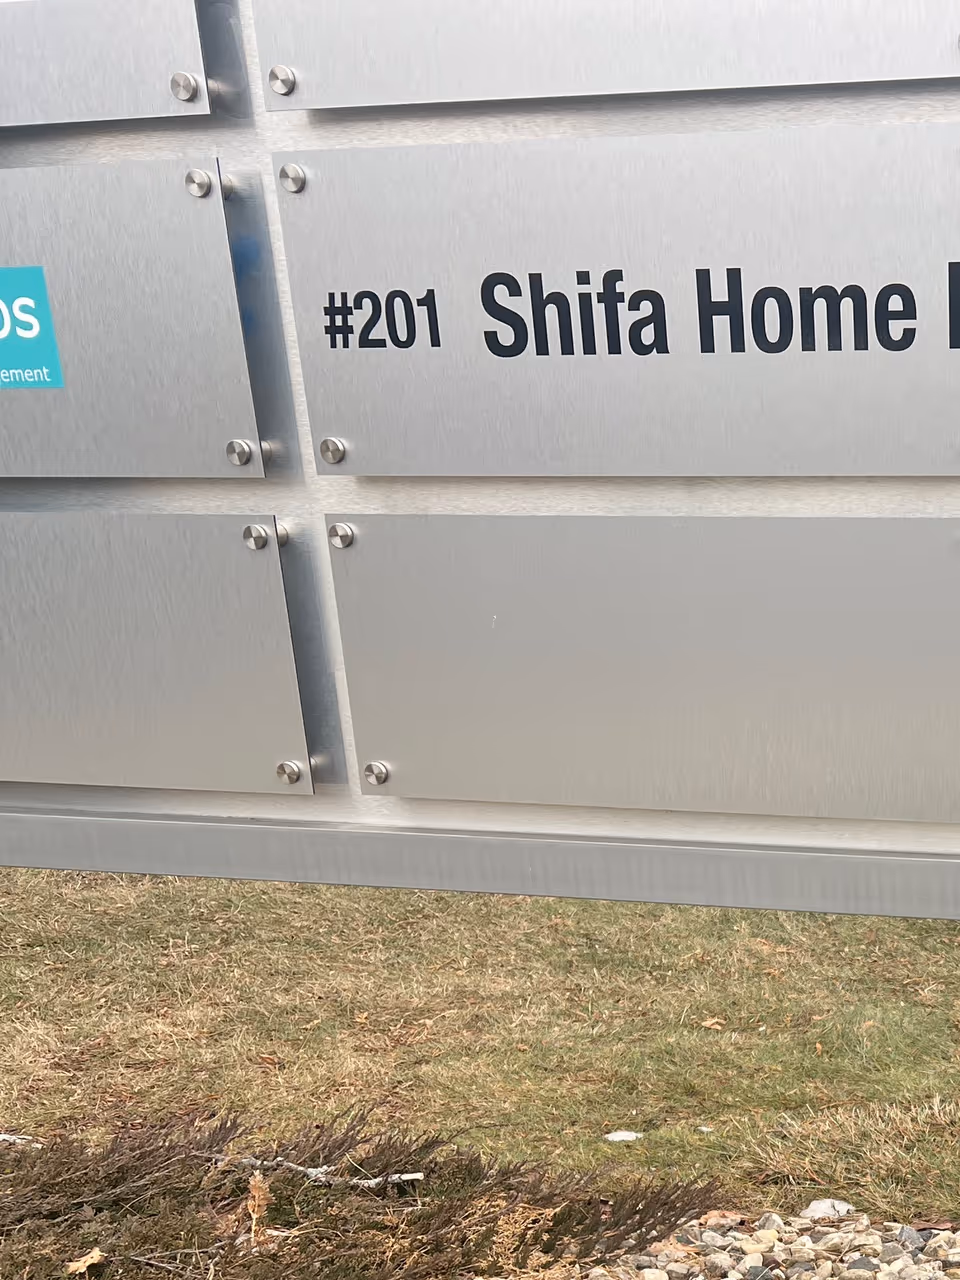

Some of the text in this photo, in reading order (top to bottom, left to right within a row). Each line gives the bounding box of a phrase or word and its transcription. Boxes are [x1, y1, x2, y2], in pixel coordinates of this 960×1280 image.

[323, 288, 441, 349] #201
[480, 269, 670, 358] Shifa
[695, 267, 917, 354] Home
